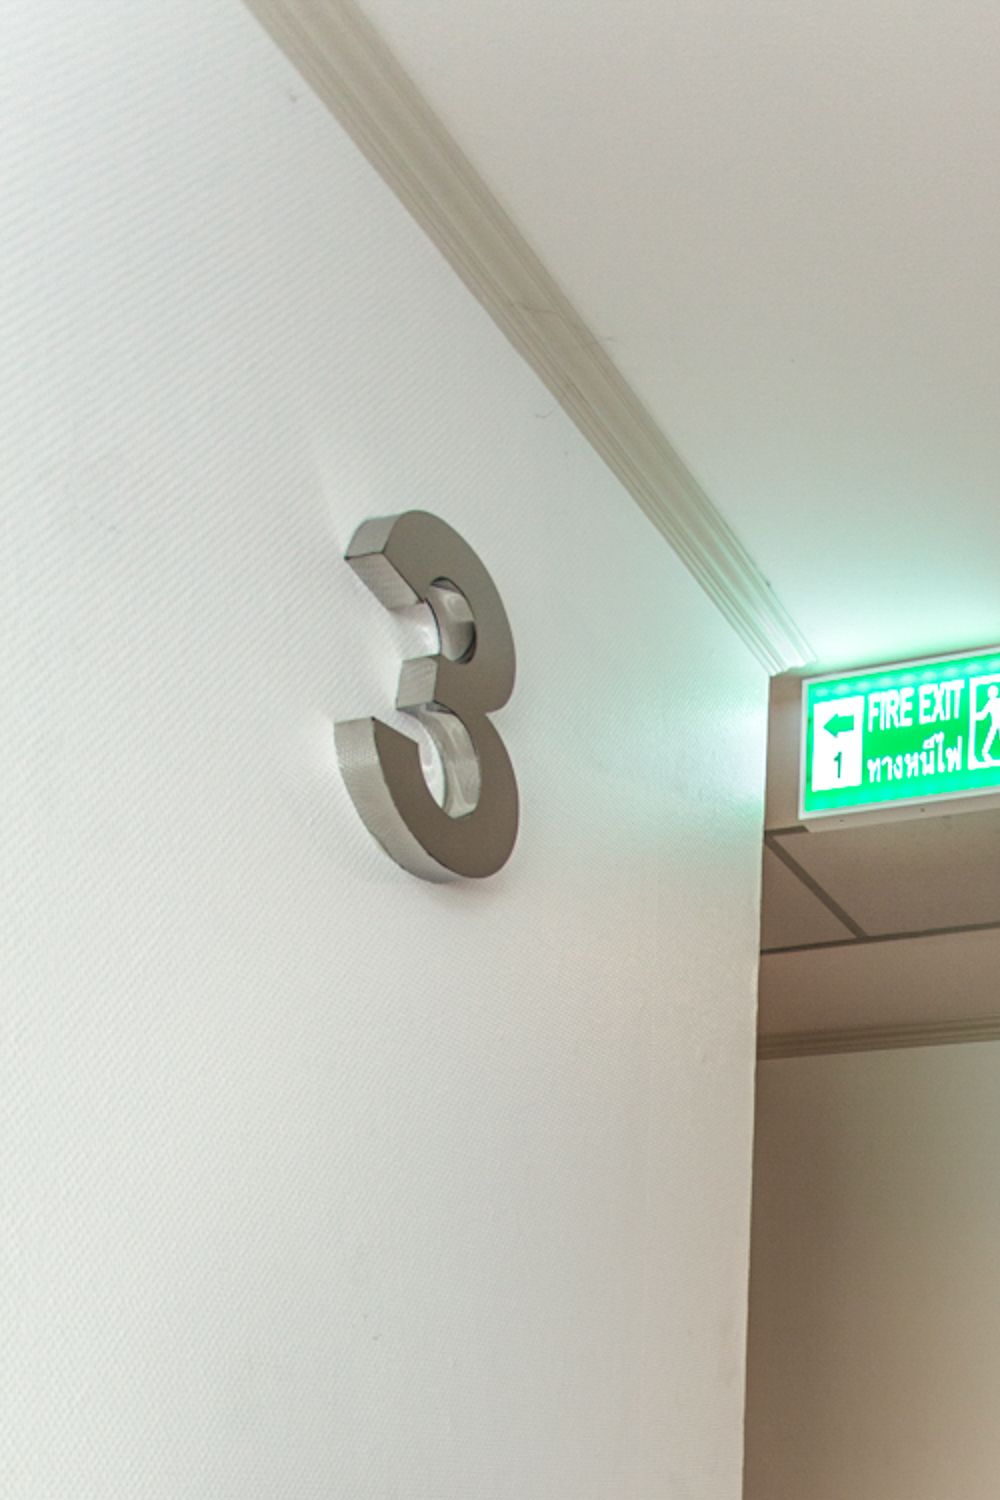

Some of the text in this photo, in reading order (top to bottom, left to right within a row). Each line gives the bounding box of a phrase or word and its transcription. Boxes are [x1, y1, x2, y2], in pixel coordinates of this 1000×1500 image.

[334, 510, 519, 883] 3
[868, 679, 965, 732] FIRE EXIT
[833, 751, 844, 779] 1
[867, 732, 963, 783] ทางหนีไฟ
